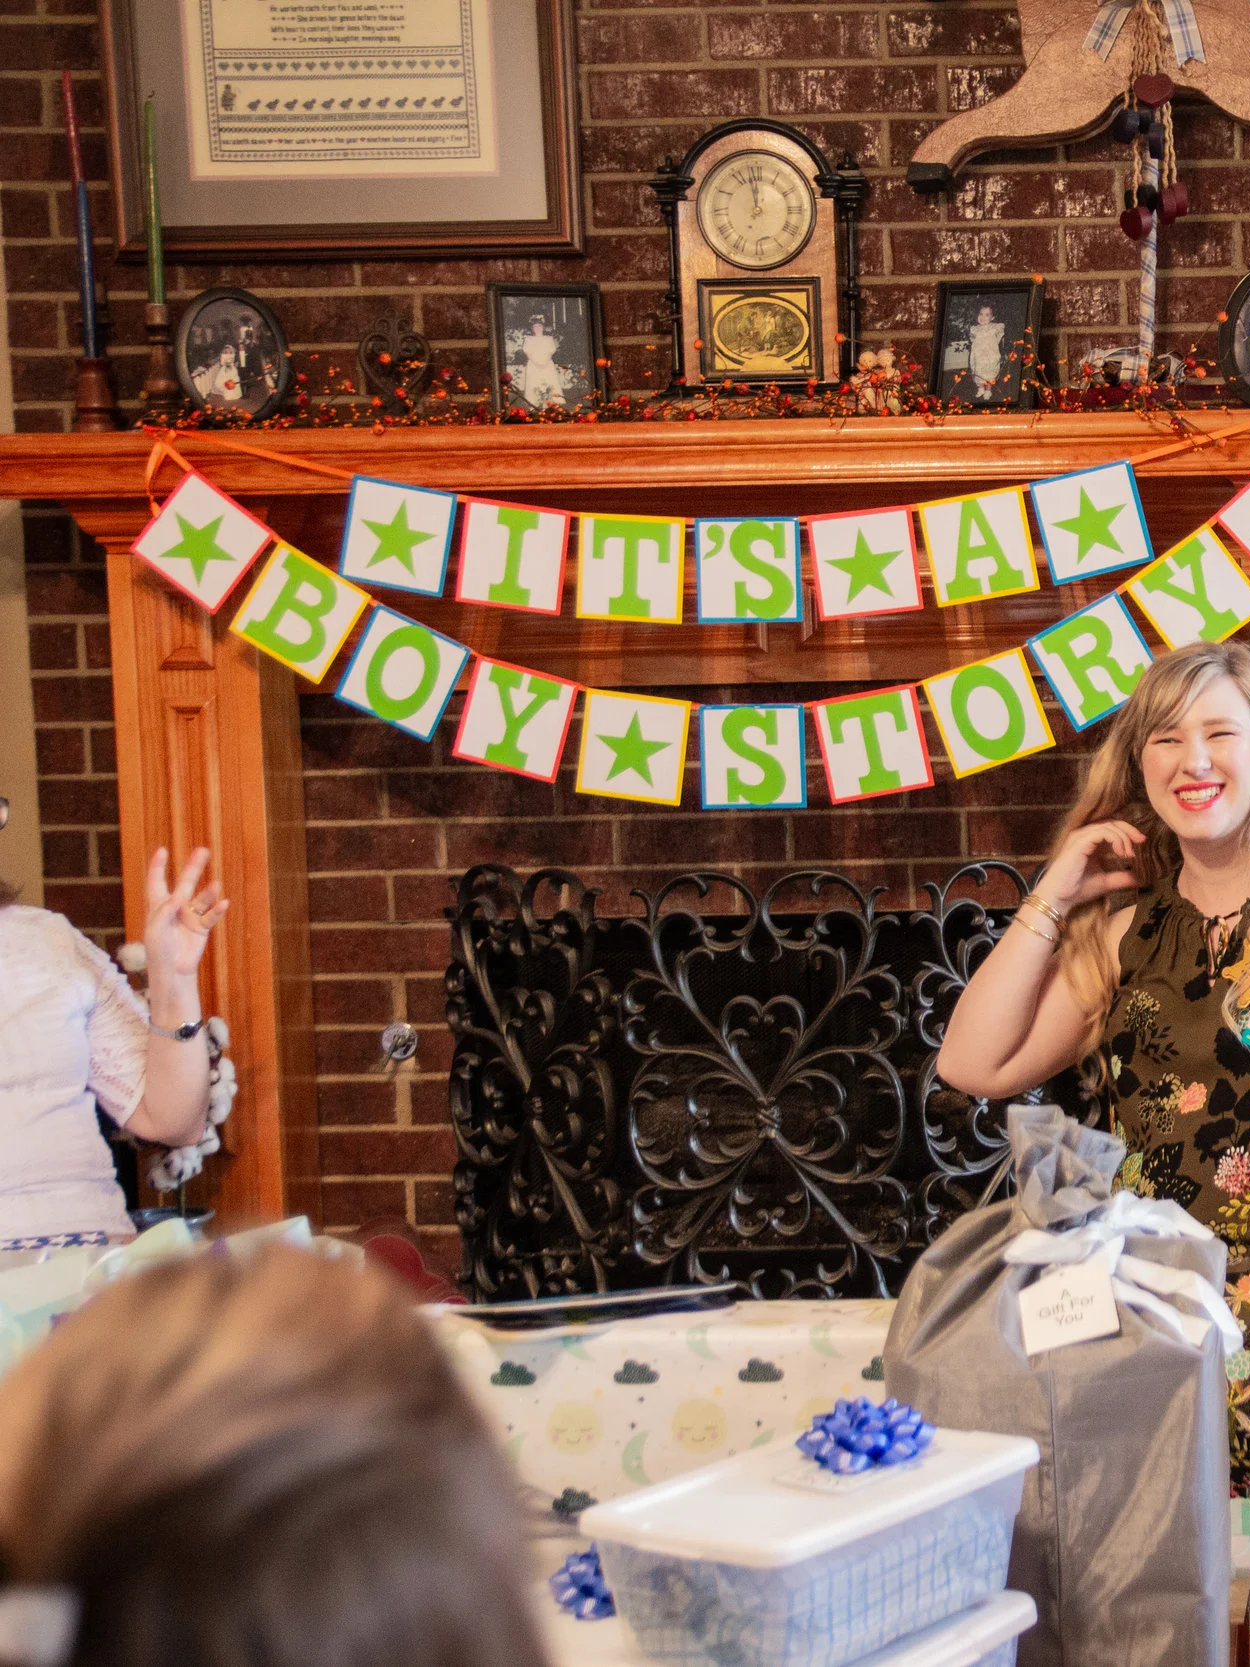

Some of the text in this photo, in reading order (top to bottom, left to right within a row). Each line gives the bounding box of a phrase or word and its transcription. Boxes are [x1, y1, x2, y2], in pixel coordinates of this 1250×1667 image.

[488, 499, 1025, 620] IT'S A
[243, 536, 1239, 805] BOY STORY
[1038, 1295, 1094, 1319] Gift For
[1061, 1289, 1071, 1301] A
[1054, 1312, 1083, 1327] You
